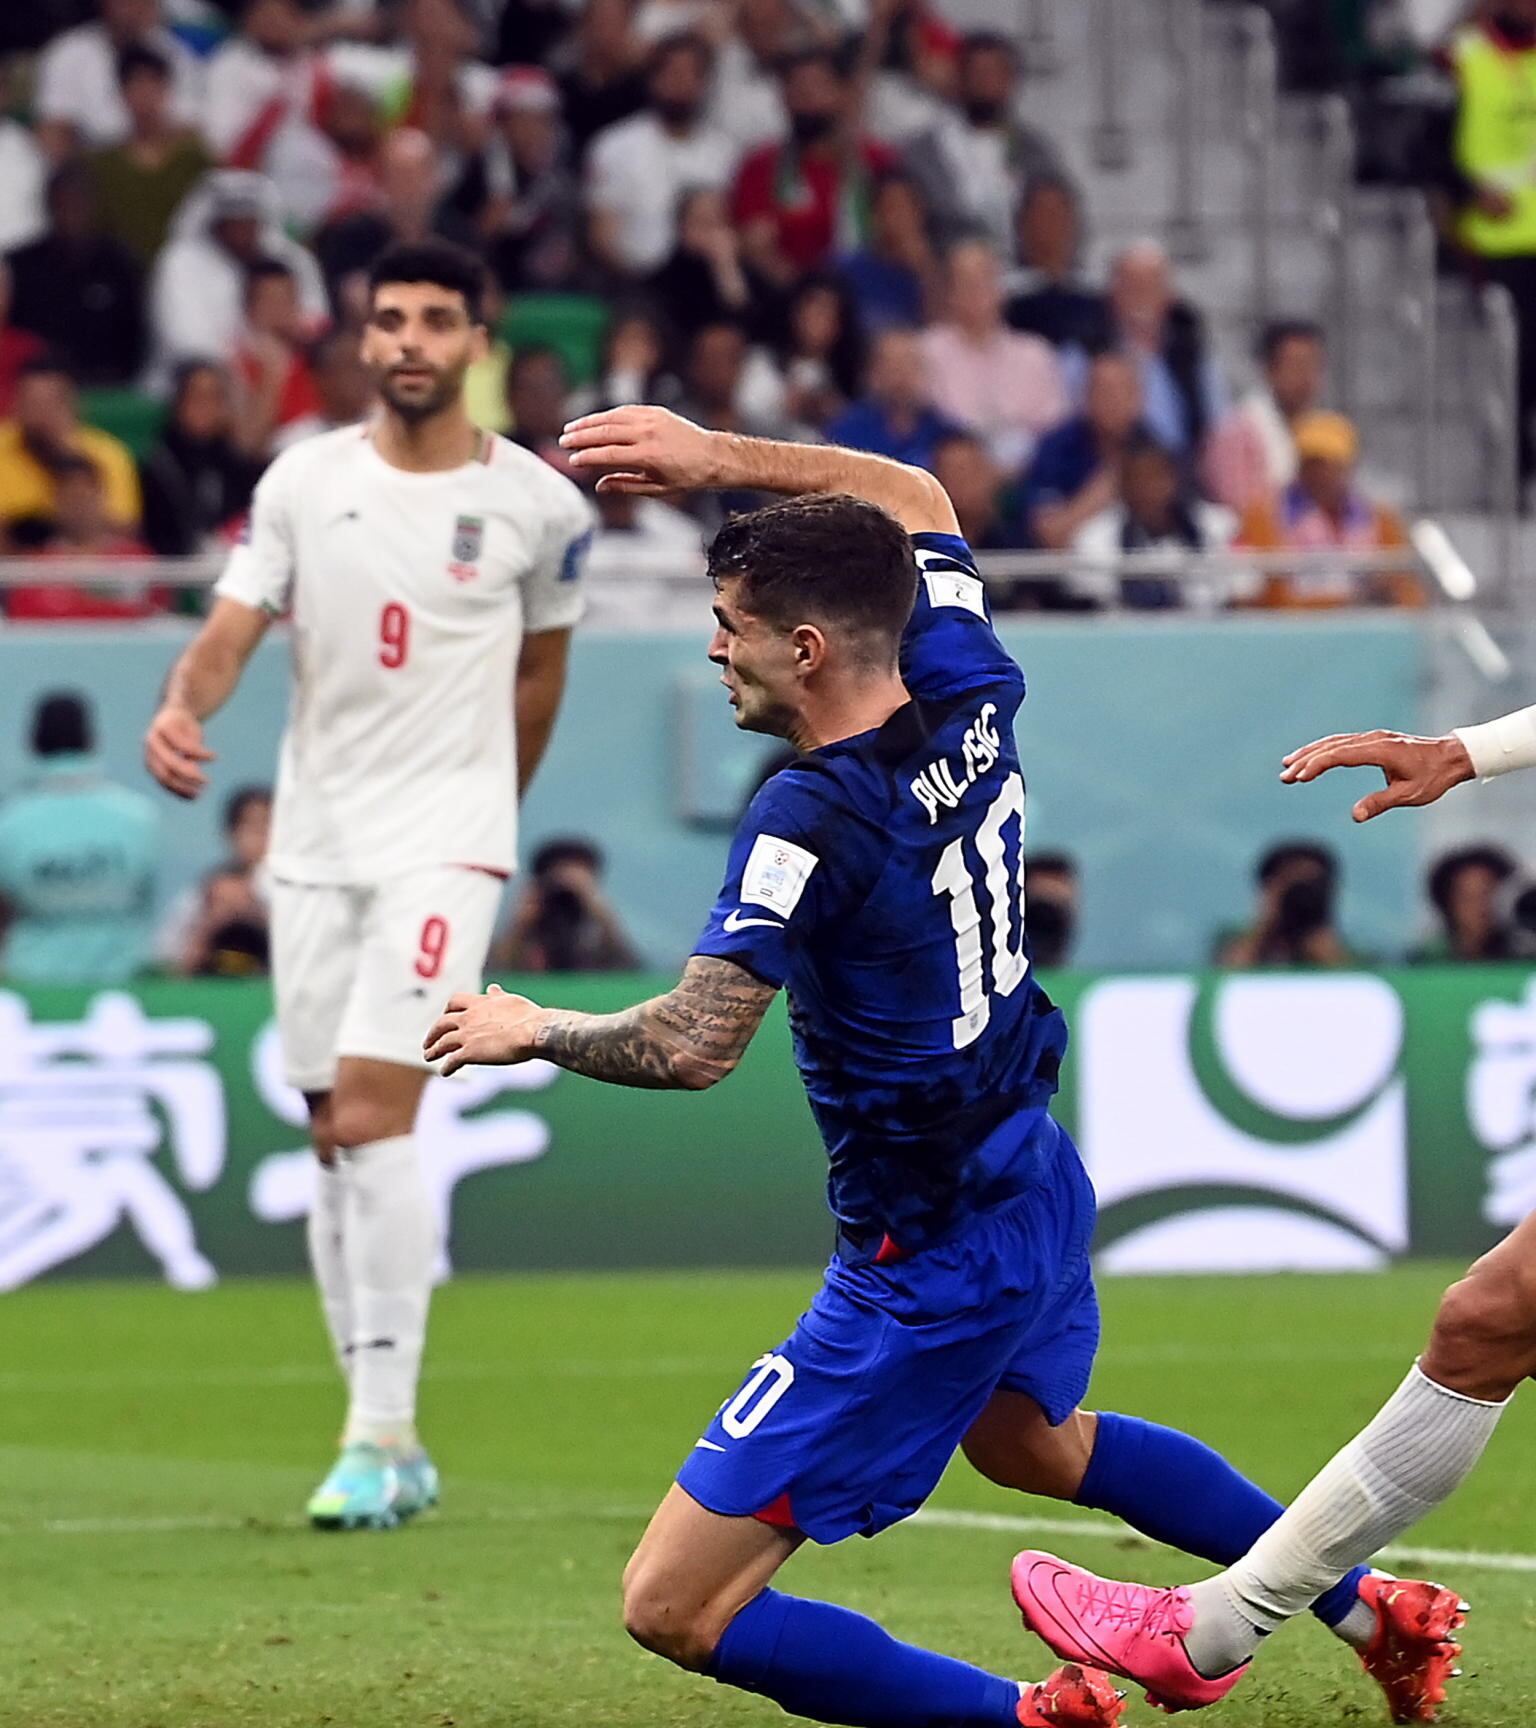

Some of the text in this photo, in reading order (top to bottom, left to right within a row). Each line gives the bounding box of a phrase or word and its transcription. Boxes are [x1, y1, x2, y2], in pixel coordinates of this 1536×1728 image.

[379, 602, 410, 668] 9
[910, 702, 1000, 826] PULISIC
[414, 916, 449, 979] 9
[931, 770, 1030, 1050] 10
